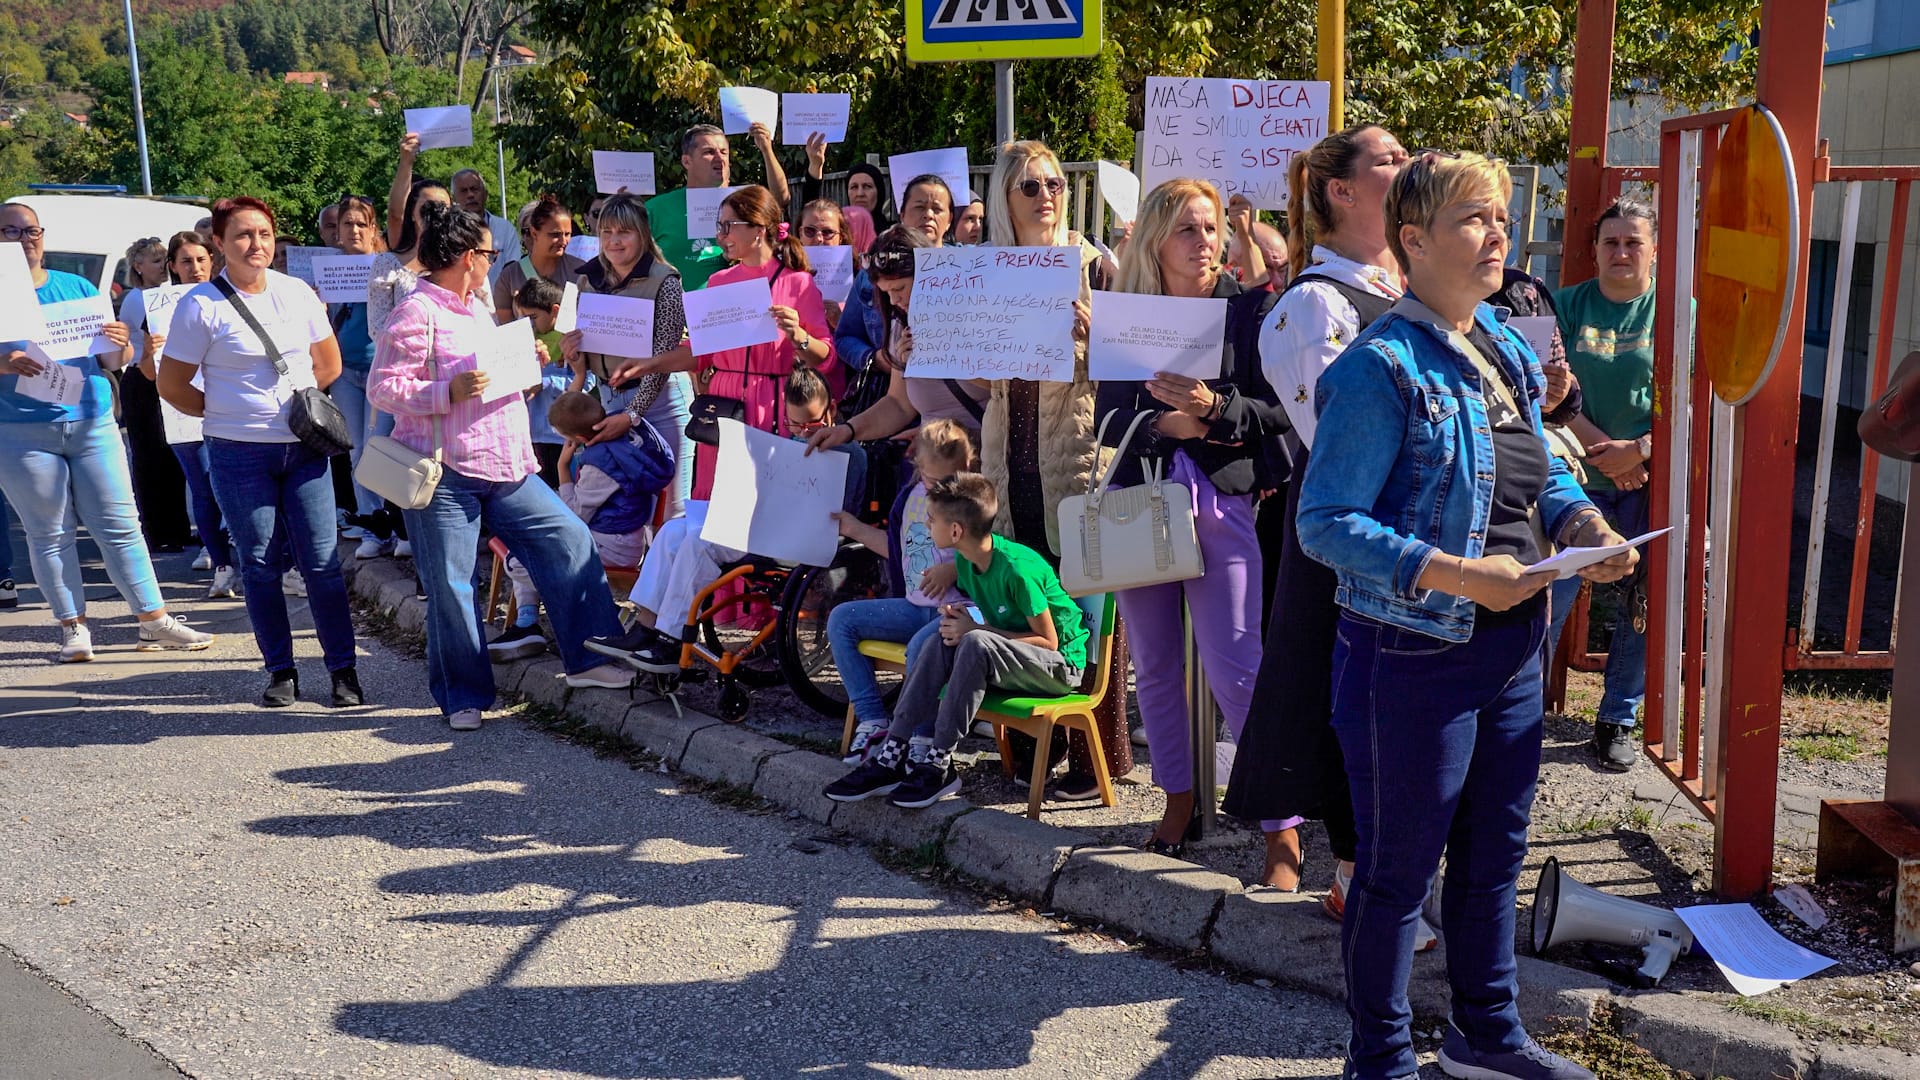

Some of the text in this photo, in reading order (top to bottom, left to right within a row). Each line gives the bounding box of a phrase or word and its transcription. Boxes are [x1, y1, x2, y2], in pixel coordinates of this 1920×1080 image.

[1151, 79, 1311, 109] NAŠA DJECA
[1152, 113, 1320, 138] NE SMIJU ČEKATI
[1151, 144, 1183, 168] DA
[1195, 146, 1226, 169] SE
[920, 247, 1070, 272] ZAR JE PREVIŠE
[918, 272, 984, 291] TRAŽITI
[915, 292, 964, 309] PRAVO
[968, 293, 988, 307] NA
[46, 321, 62, 329] ECU
[63, 318, 78, 326] STE
[75, 324, 93, 333] DATI
[913, 311, 1025, 328] NA DOSTUPNOST
[80, 330, 106, 340] PRIPA
[912, 327, 1015, 341] SPECIJALISTE
[956, 340, 975, 351] NA
[976, 341, 1029, 354] TERMIN
[1034, 344, 1069, 362] BEZ
[1140, 340, 1178, 349] DOVOLJNO
[961, 356, 1053, 378] MJESECIMA
